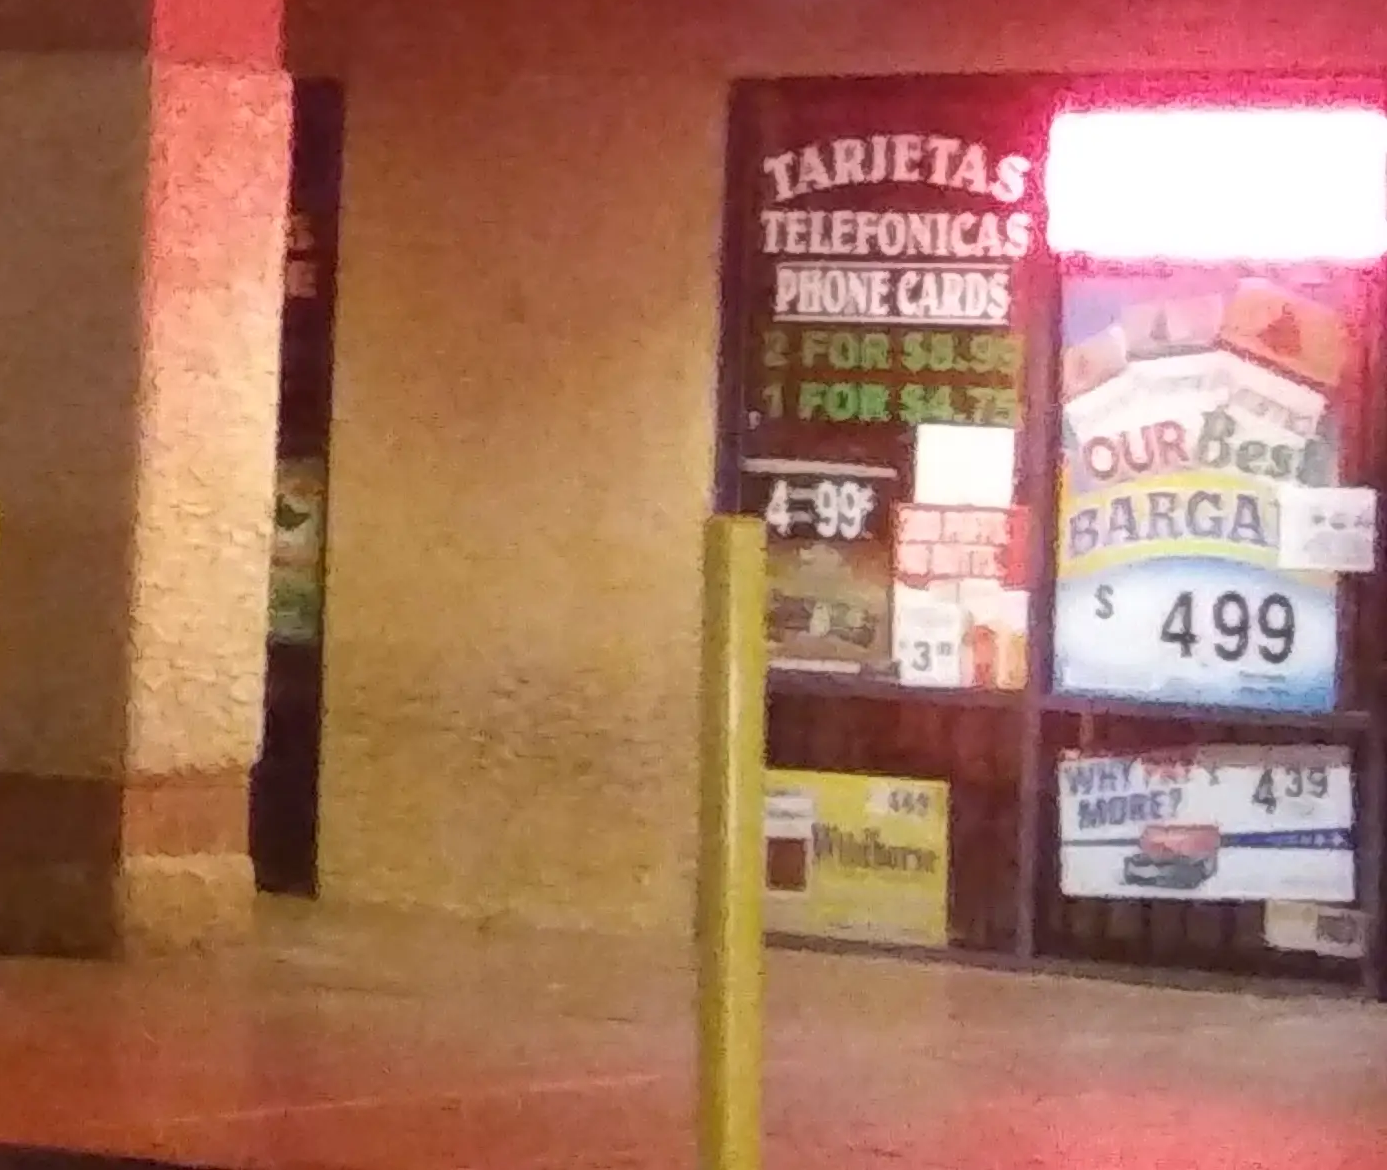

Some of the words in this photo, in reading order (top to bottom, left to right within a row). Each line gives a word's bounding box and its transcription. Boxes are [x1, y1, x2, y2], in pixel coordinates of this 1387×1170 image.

[763, 133, 1031, 202] TARJETAS
[761, 209, 1031, 257] TELEFONICAS
[775, 268, 890, 316] PHONE
[896, 270, 1010, 320] CARDS
[766, 329, 789, 367] 2
[801, 330, 891, 370] FOR
[763, 383, 784, 419] 1
[799, 383, 891, 422] FOR
[1085, 420, 1190, 481] OUR
[1069, 490, 1280, 558] BARGA
[1094, 584, 1114, 620] $
[1160, 590, 1295, 664] 499
[1068, 758, 1132, 795] WHY
[1079, 787, 1182, 829] MORE?
